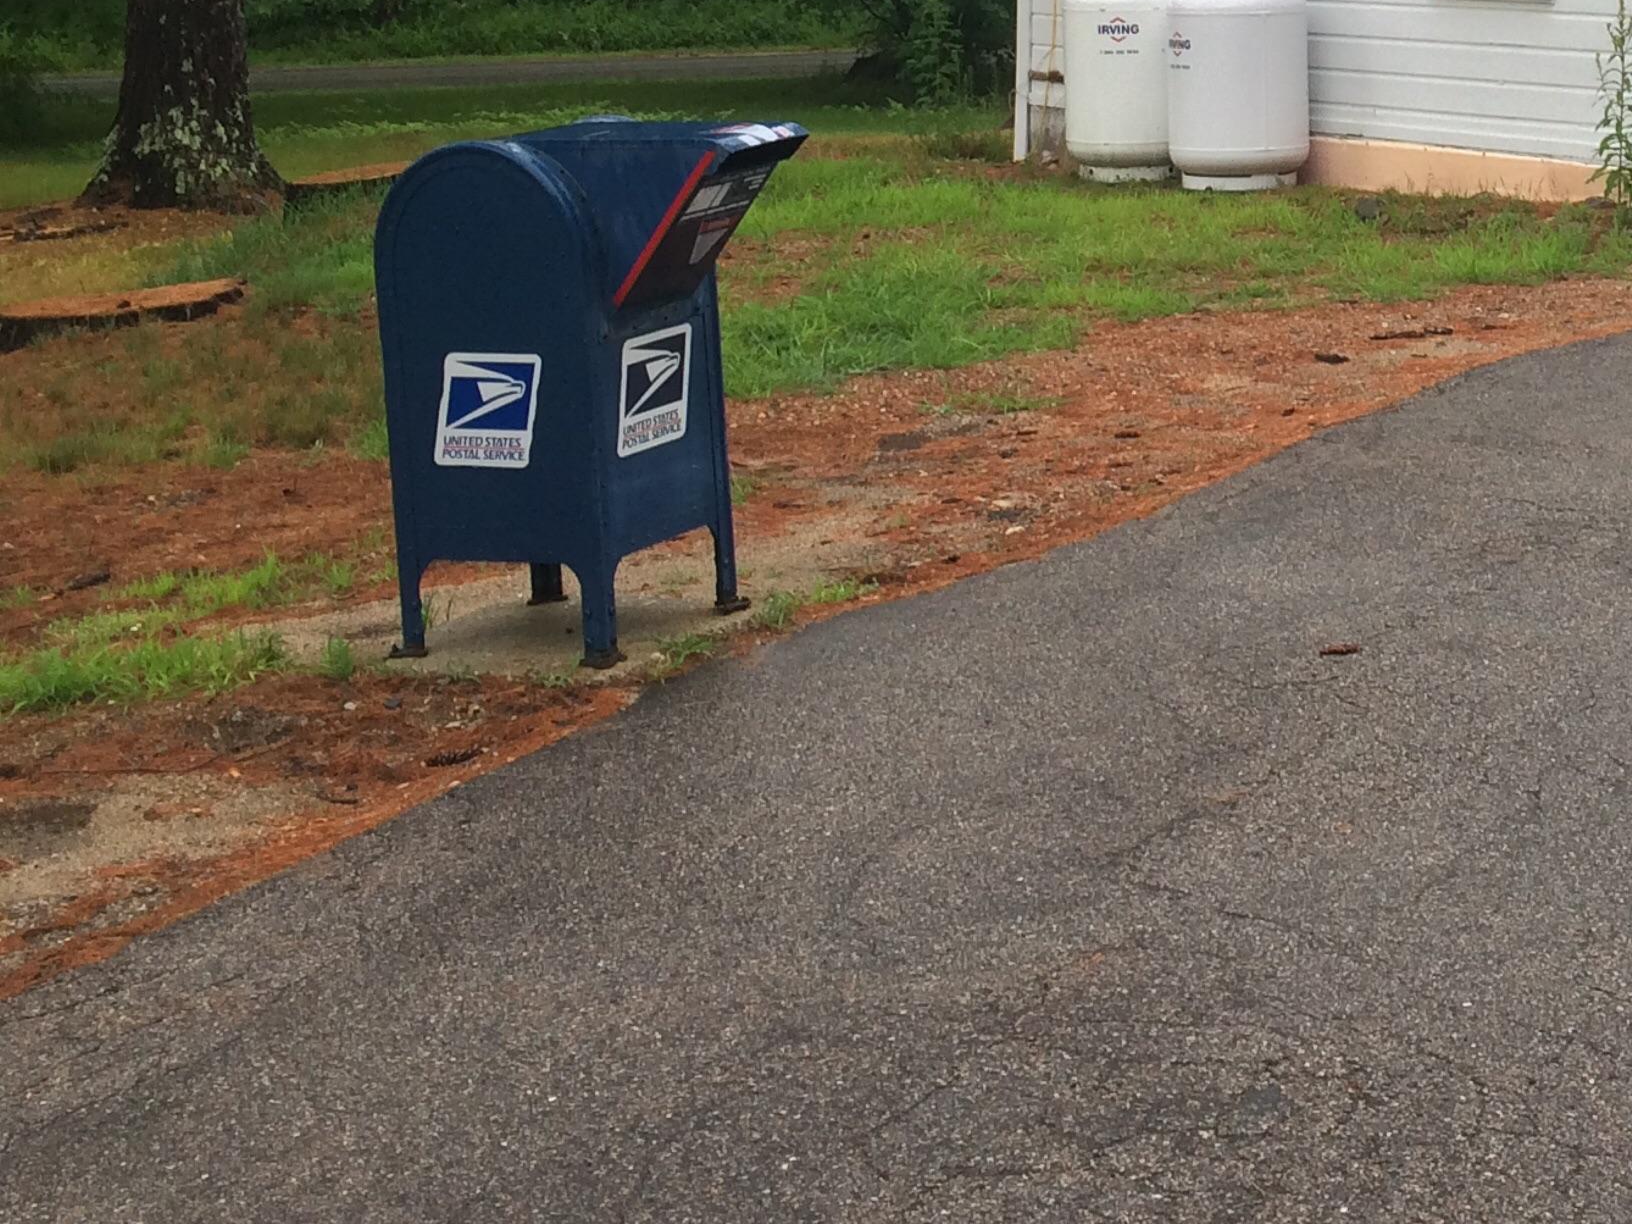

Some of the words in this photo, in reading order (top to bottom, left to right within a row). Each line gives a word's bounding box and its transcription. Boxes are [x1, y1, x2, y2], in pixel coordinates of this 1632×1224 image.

[1098, 24, 1139, 35] IRVING
[623, 417, 652, 436] UNITED
[653, 408, 679, 425] STATES
[443, 436, 483, 446] UNITED
[485, 437, 522, 448] STATES
[622, 432, 650, 450] POSTAL
[651, 423, 681, 440] SERVICE
[442, 449, 481, 460] POSTAL
[483, 449, 526, 461] SERVICE
